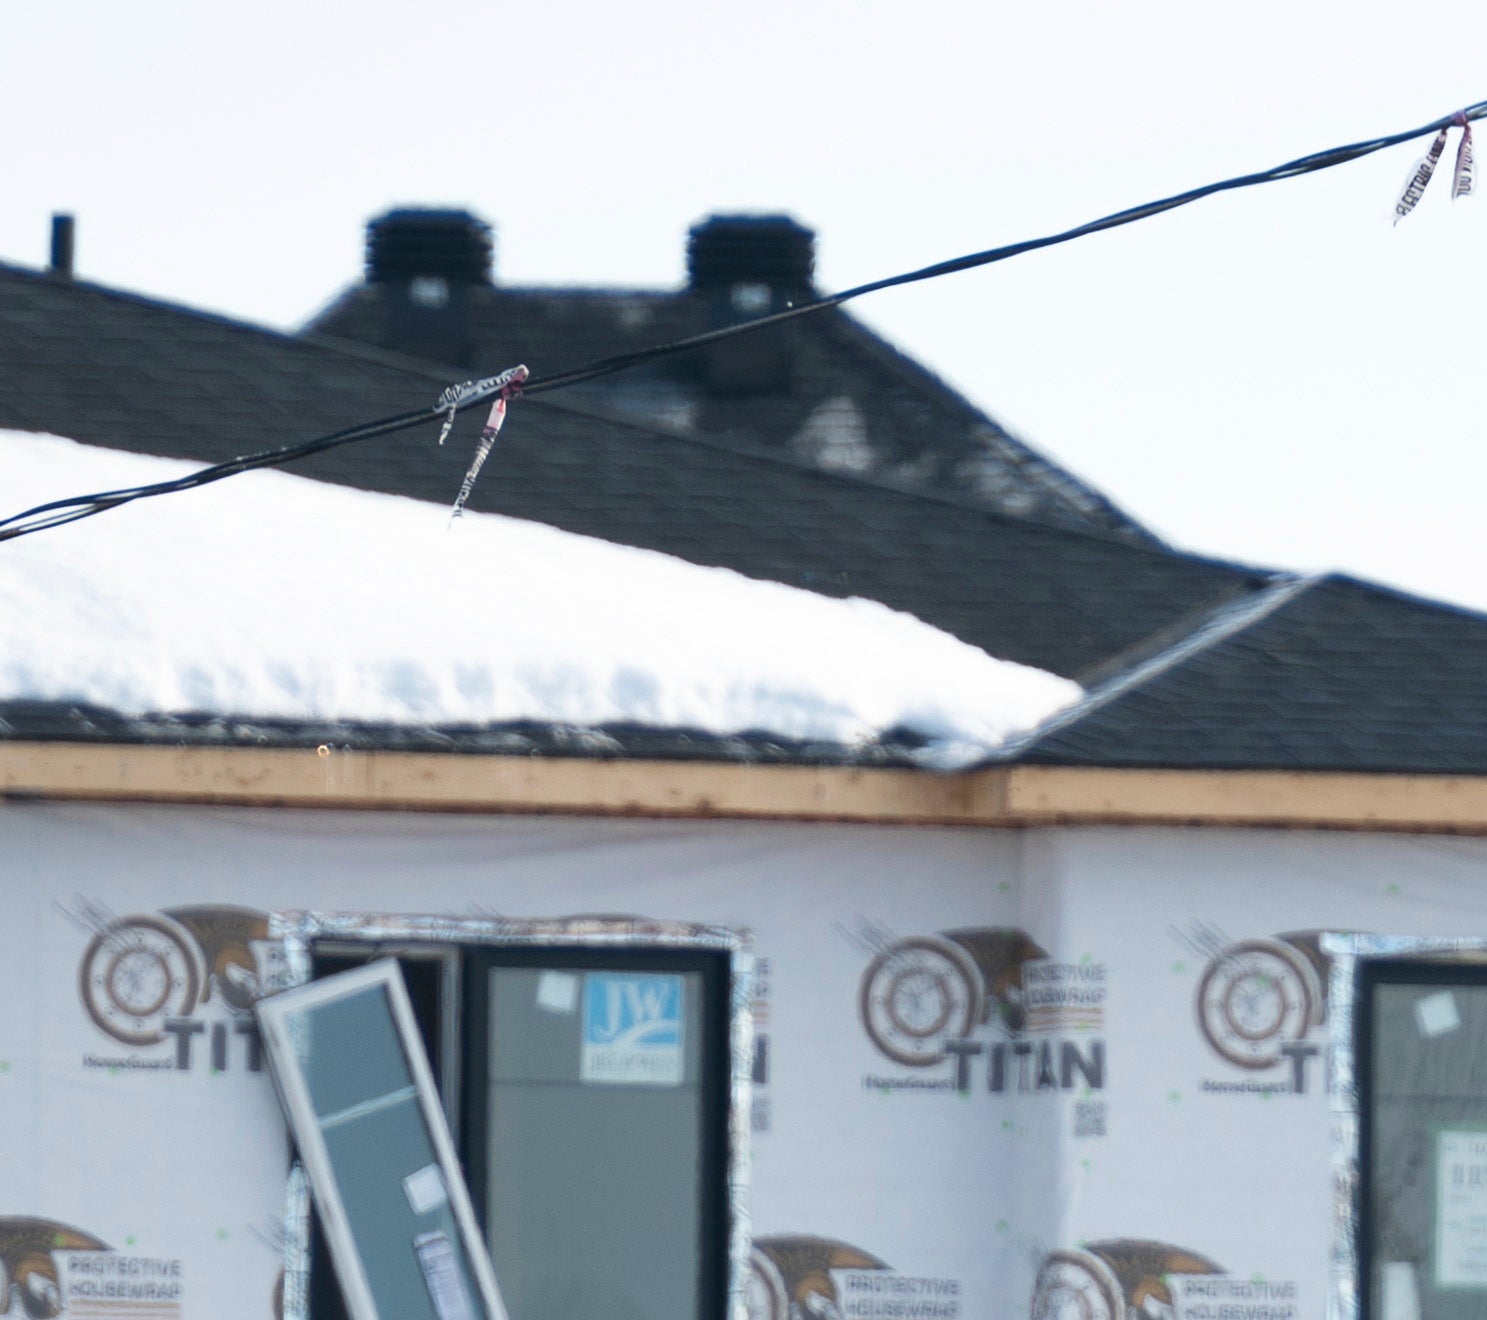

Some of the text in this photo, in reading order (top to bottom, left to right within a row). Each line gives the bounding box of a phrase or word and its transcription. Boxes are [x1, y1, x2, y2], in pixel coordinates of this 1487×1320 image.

[163, 1018, 262, 1071] TIT
[945, 1039, 1104, 1091] TITAN
[68, 1256, 181, 1275] PROTECTIVE
[68, 1281, 181, 1298] HOUSEWRAP
